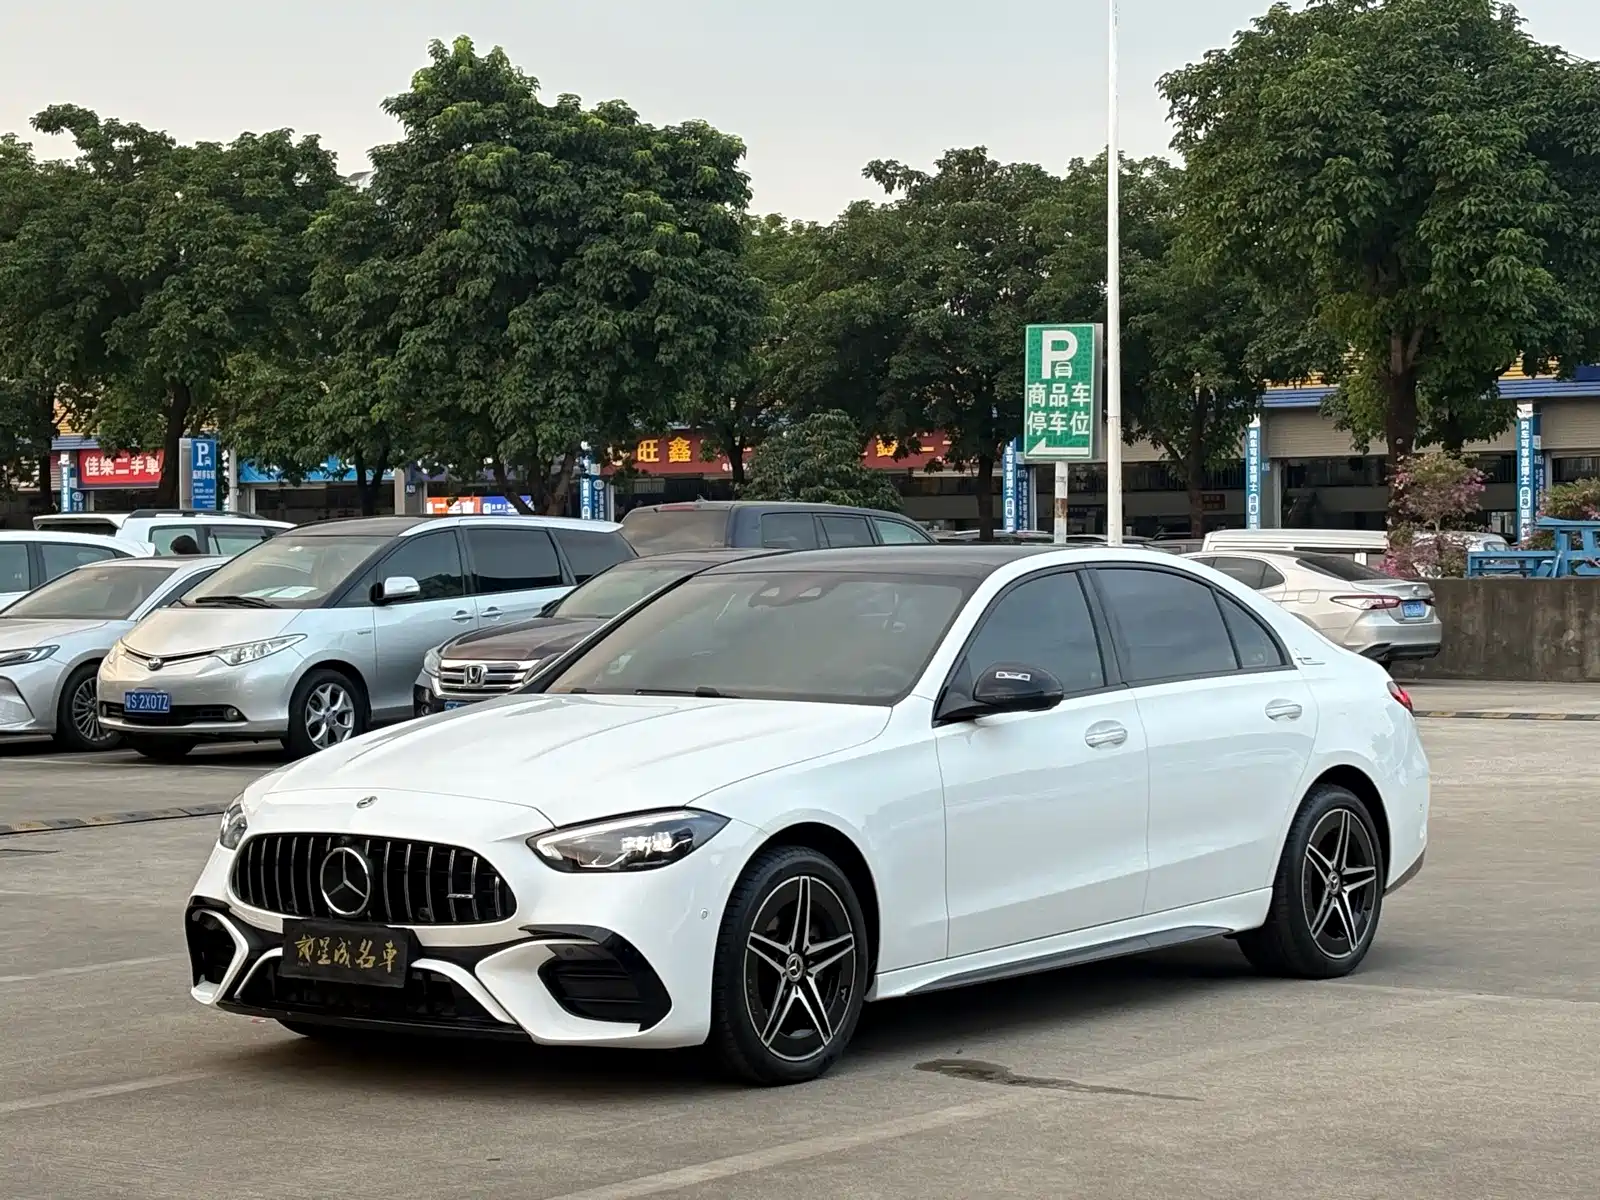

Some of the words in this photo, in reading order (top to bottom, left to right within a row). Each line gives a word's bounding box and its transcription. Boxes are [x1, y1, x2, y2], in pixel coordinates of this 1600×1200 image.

[1041, 330, 1078, 379] P
[1027, 382, 1091, 407] 商品车
[1026, 410, 1090, 436] 停车位
[196, 442, 209, 467] P
